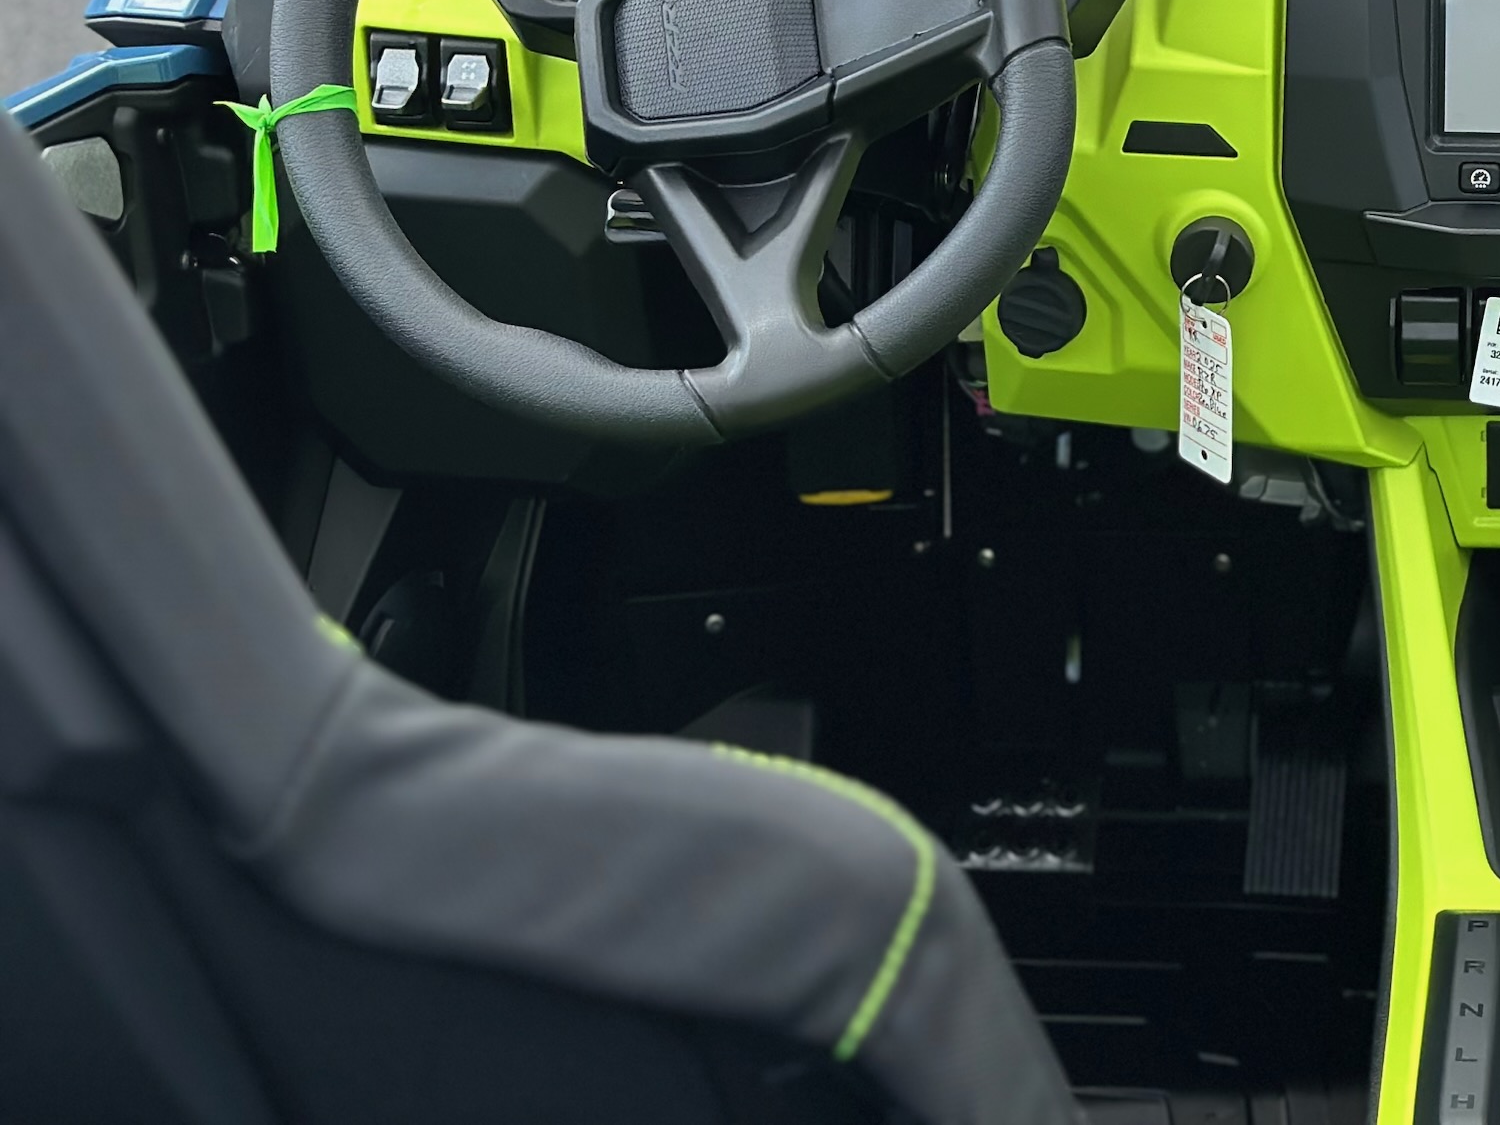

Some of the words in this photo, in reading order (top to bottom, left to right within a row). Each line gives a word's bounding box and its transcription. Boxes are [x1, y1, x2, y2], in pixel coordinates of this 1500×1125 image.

[1467, 919, 1490, 932] P
[1463, 960, 1487, 974] R
[1459, 1003, 1484, 1017] N
[1455, 1047, 1478, 1063] L
[1450, 1094, 1476, 1109] H
